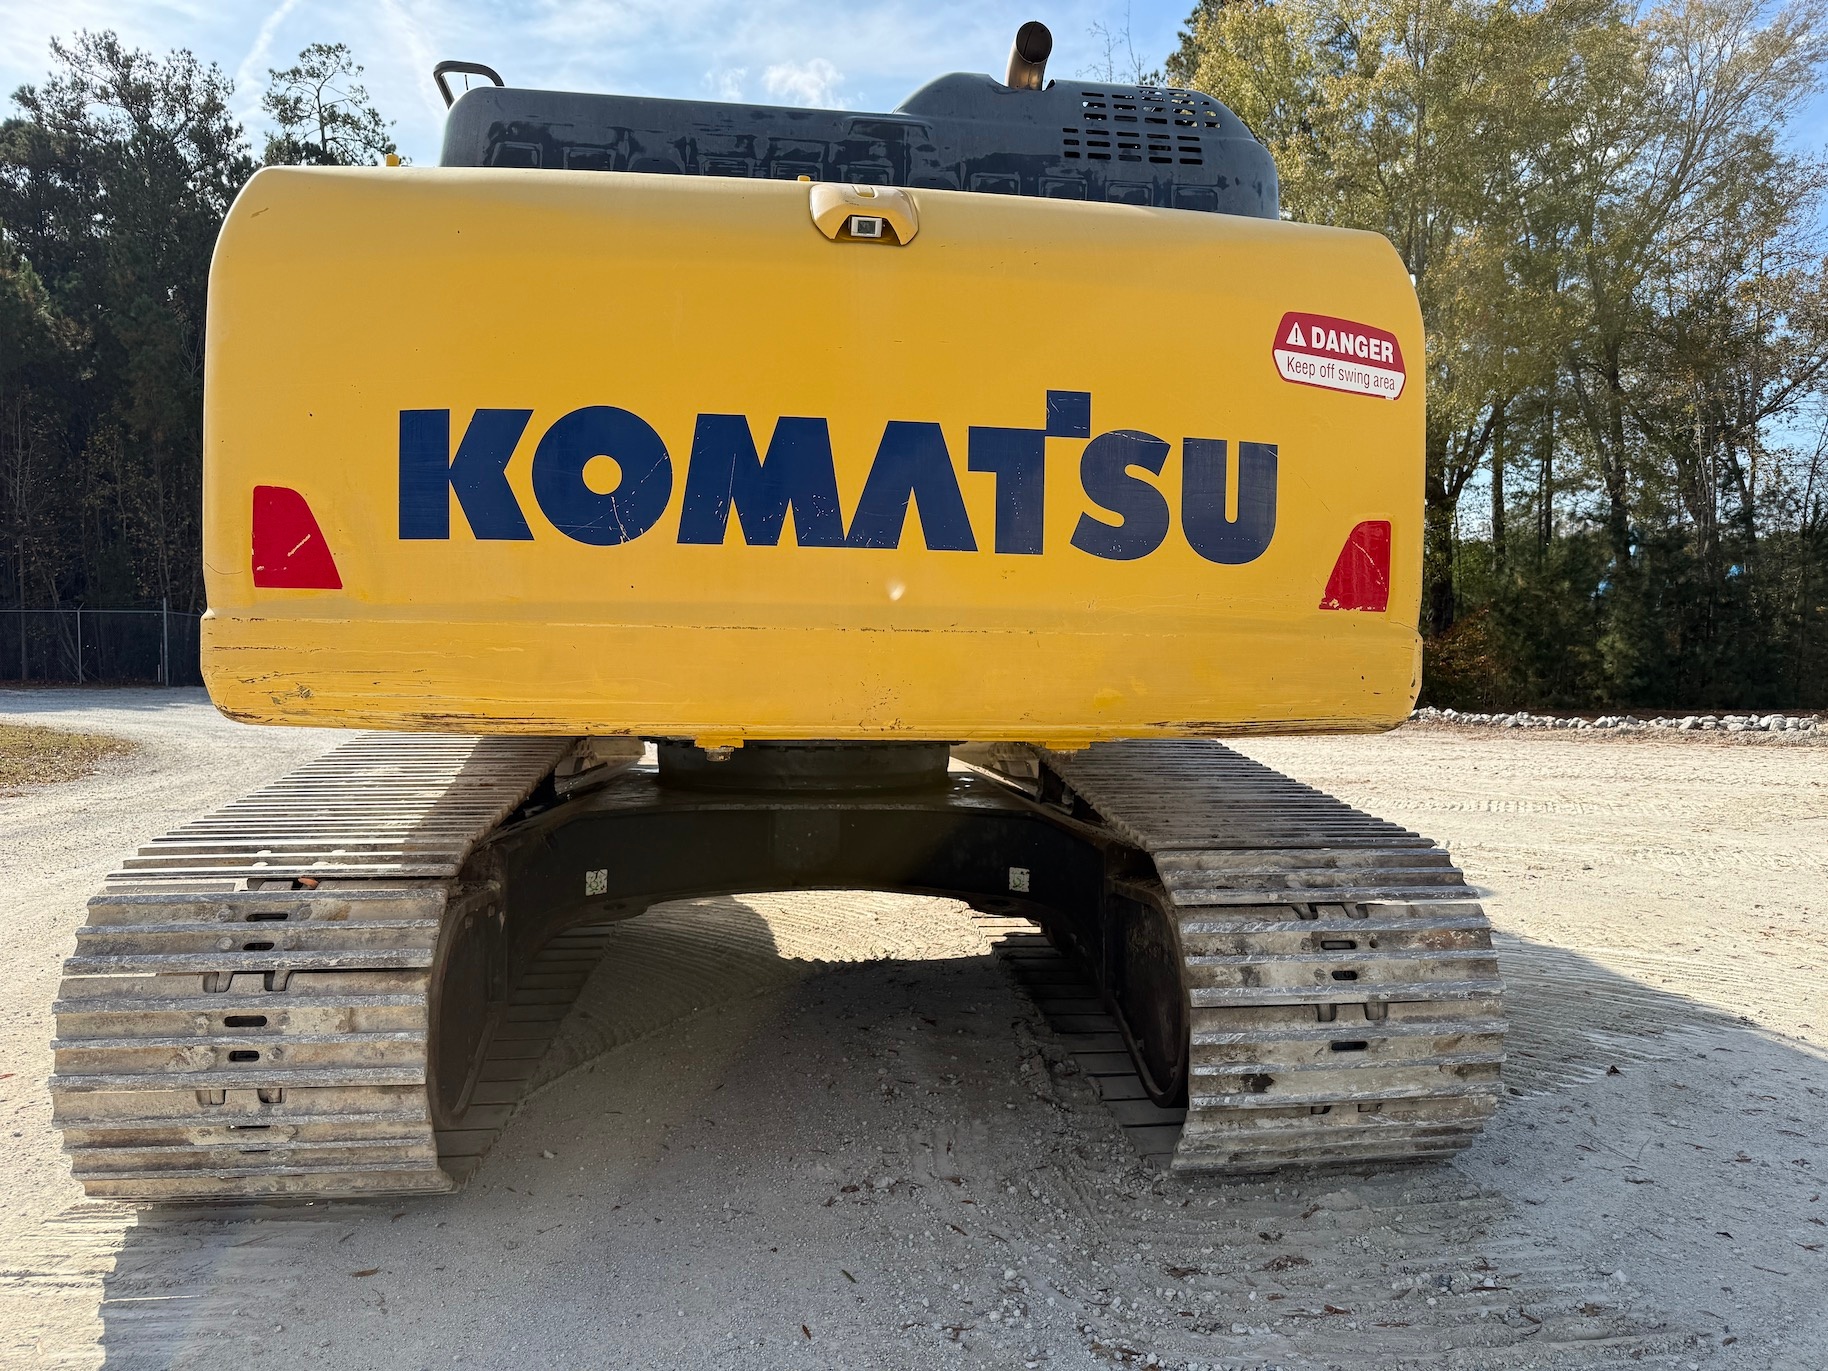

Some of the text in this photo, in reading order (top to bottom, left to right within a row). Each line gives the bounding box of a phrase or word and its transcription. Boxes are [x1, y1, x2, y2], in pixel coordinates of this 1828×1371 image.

[1311, 326, 1394, 364] DANGER
[1287, 355, 1395, 391] Keep off swing area
[399, 389, 1279, 565] KOMATSU
